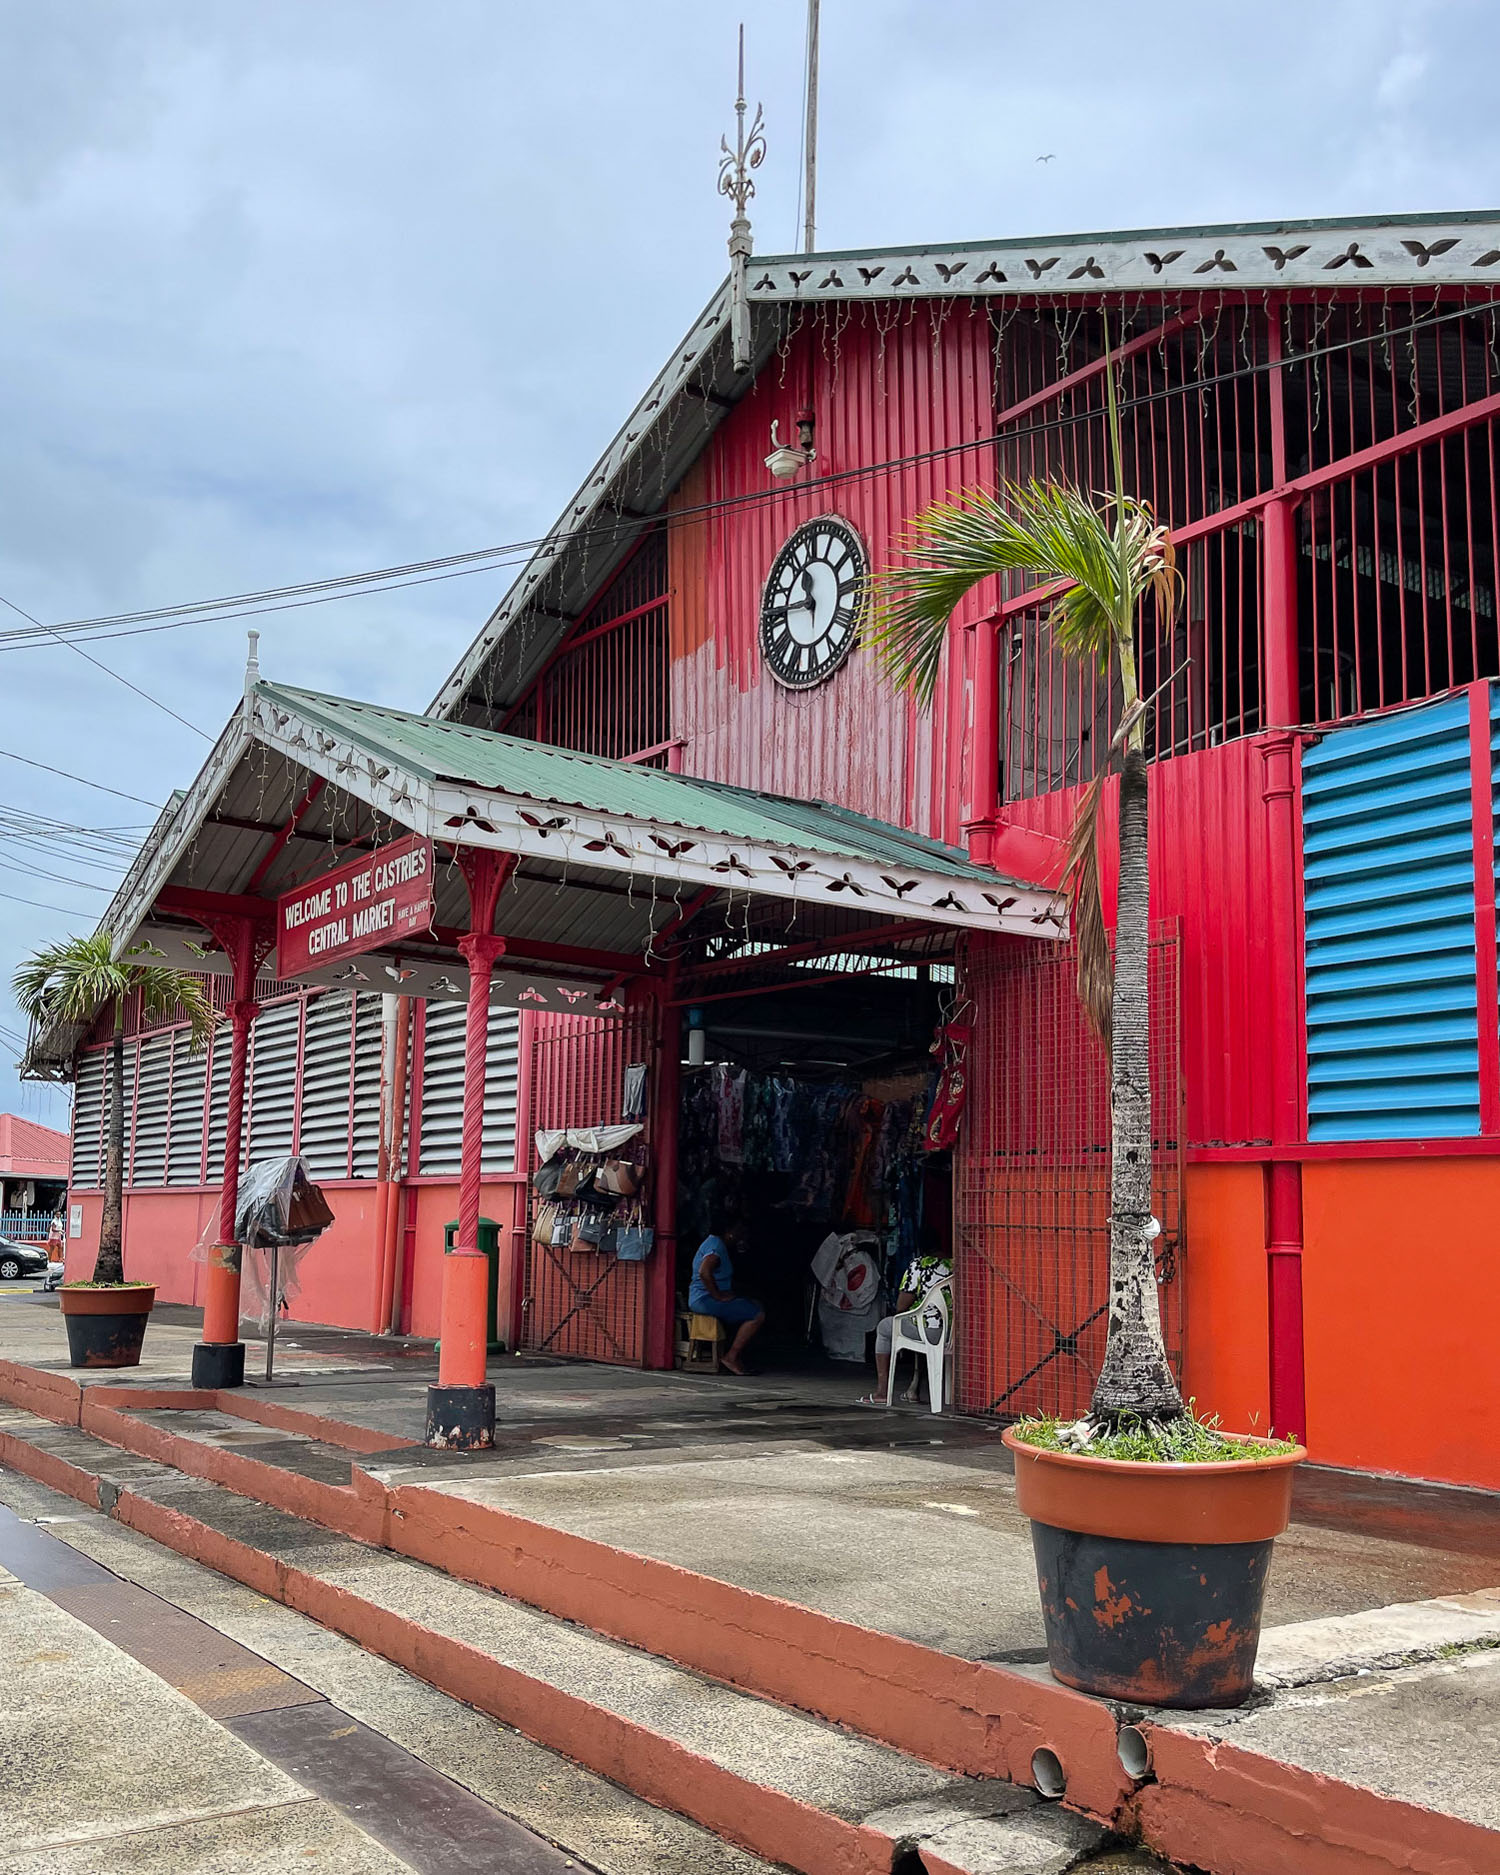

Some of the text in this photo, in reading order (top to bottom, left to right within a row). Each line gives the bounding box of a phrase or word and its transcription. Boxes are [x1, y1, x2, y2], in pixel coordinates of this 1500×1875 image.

[285, 847, 426, 930] WELCOME TO THE CASTRIES
[308, 898, 396, 955] CENTRAL MARKET
